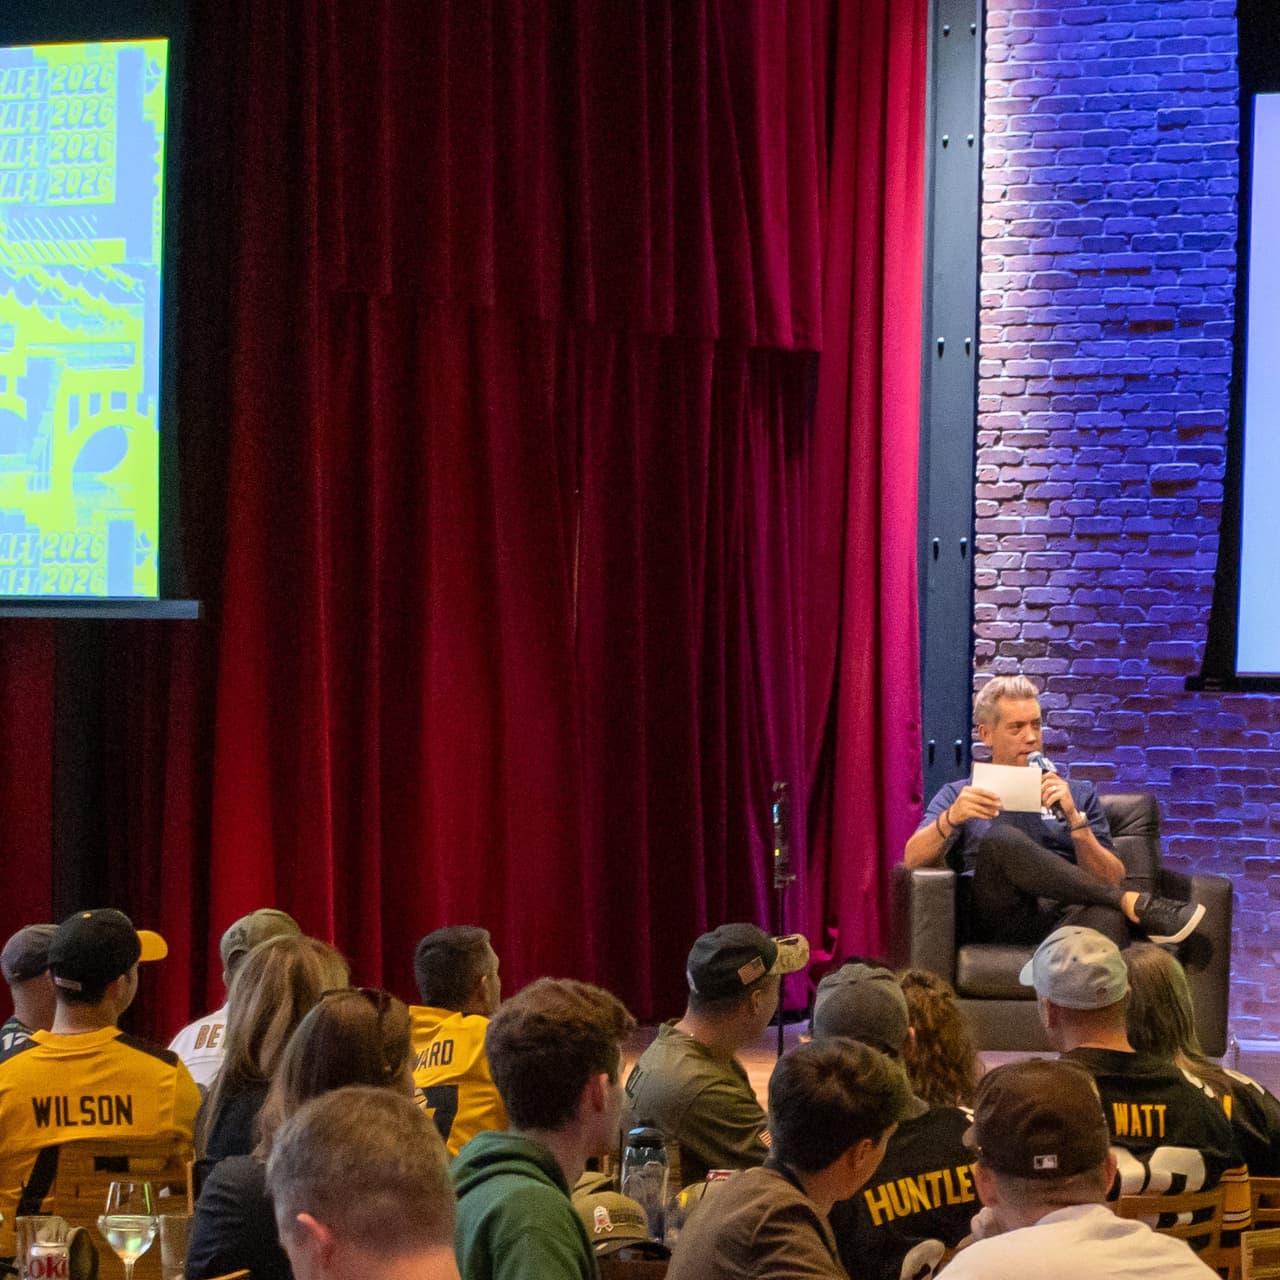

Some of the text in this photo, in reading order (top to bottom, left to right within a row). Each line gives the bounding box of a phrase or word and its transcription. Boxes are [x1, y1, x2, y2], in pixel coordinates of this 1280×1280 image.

[194, 1024, 224, 1049] BE
[416, 1040, 454, 1073] ARD
[32, 1094, 134, 1127] WILSON
[1112, 1103, 1167, 1138] WATT
